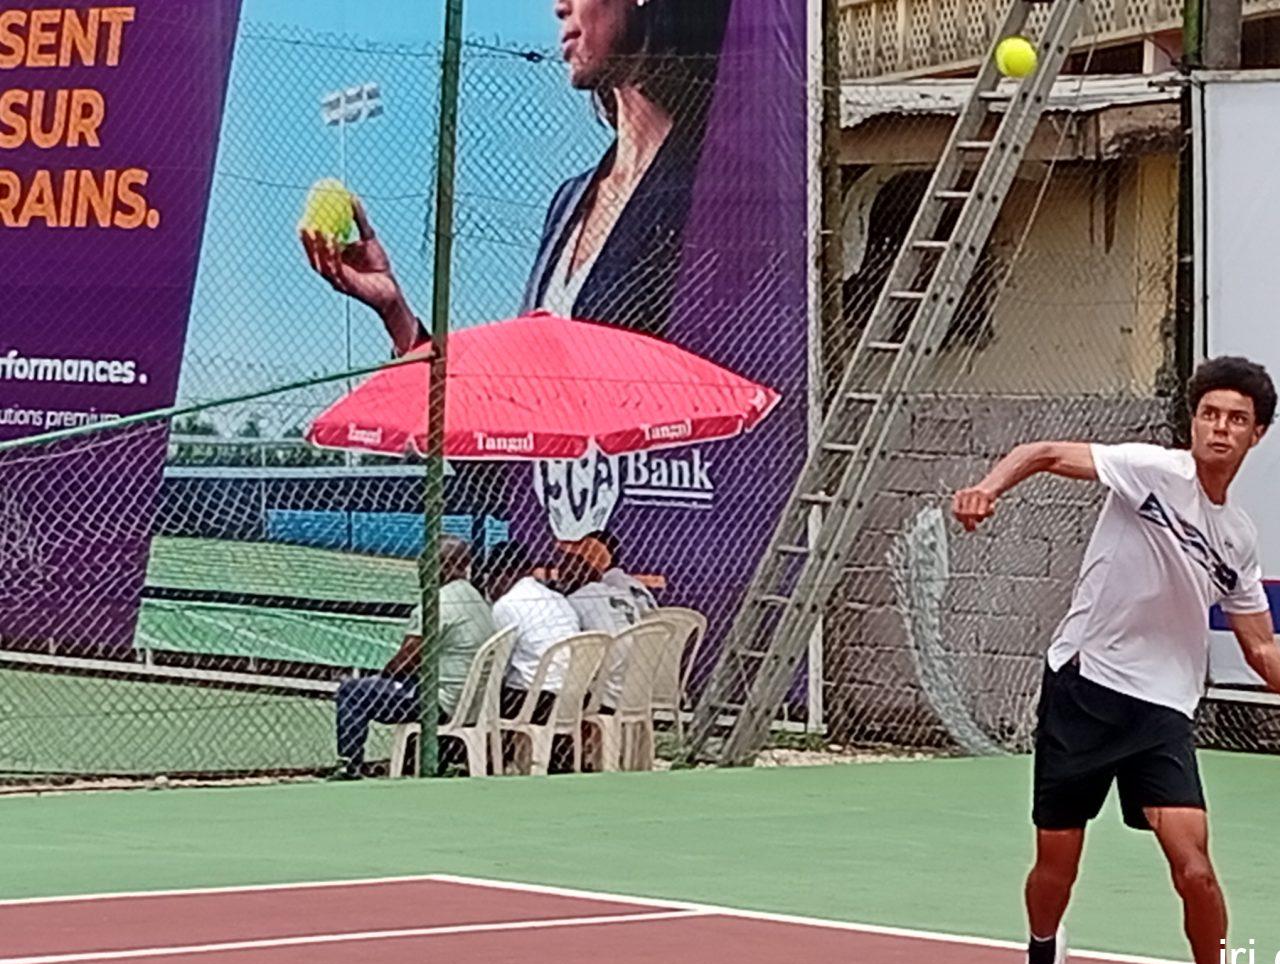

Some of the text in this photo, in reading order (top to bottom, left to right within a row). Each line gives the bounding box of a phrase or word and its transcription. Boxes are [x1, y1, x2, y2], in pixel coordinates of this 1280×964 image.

[0, 7, 135, 69] SENT
[0, 89, 105, 149] SUR
[0, 168, 160, 230] RAINS.
[625, 449, 714, 490] Bank
